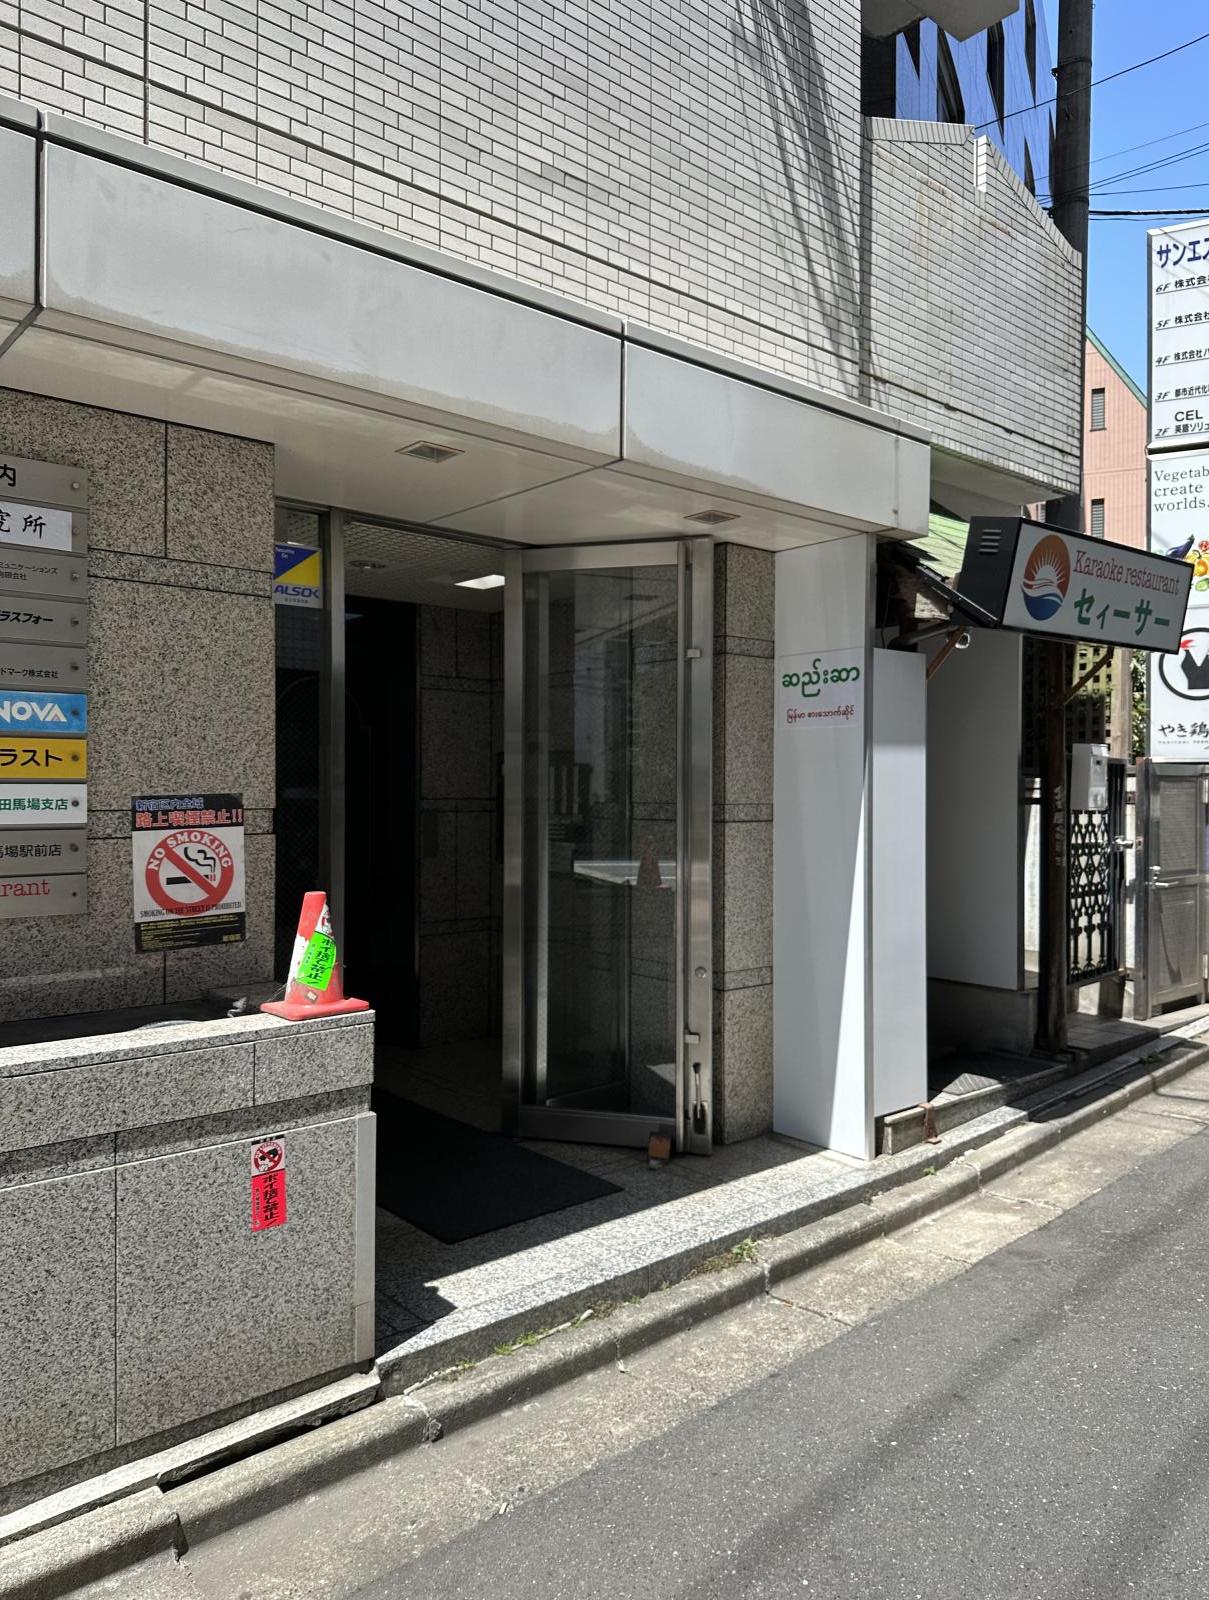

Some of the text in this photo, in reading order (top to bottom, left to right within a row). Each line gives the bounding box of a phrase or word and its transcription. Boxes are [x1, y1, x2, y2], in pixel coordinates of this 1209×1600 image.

[1156, 275, 1209, 293] 6F 株式会
[1157, 319, 1170, 328] 5F
[1155, 355, 1170, 364] 4F
[1155, 384, 1209, 400] 3F 都市近代化
[1174, 410, 1203, 422] CEL
[1155, 427, 1170, 436] 2F
[1154, 482, 1203, 497] create
[1154, 497, 1209, 512] worlds.
[1073, 551, 1180, 595] Karaoke restaurant
[0, 701, 67, 723] NOVA
[0, 749, 63, 767] ラスト
[0, 798, 68, 810] 田馬場支店
[0, 844, 62, 858] 場駅前店
[148, 831, 232, 871] NO SMOKING
